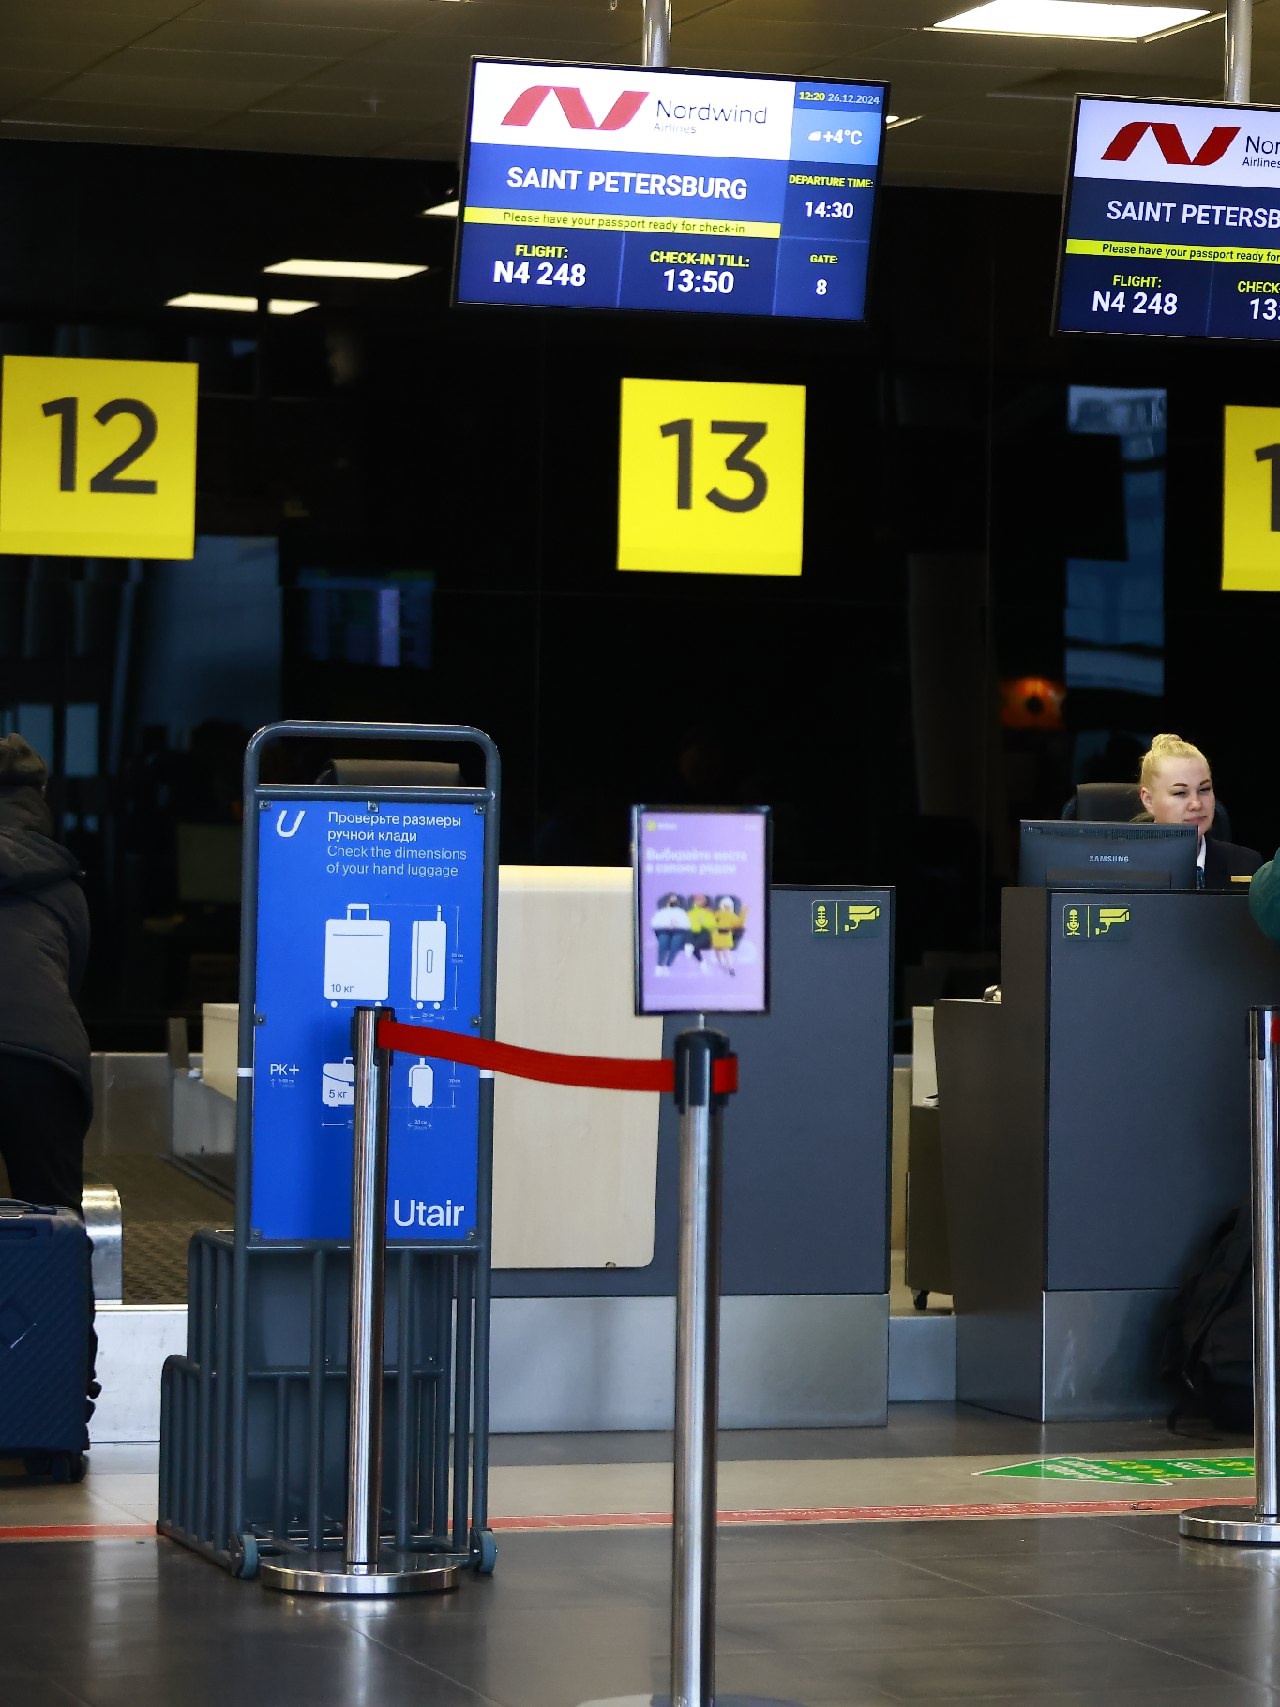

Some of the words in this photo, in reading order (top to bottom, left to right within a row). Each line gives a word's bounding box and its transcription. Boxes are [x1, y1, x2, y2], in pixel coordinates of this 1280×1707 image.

[799, 91, 825, 101] 12:20
[827, 93, 880, 105] 26.12.2024
[656, 99, 767, 126] Nordwind
[507, 166, 582, 190] SAINT
[588, 172, 747, 200] PETERSBURG
[789, 174, 844, 187] DEPARTURE
[847, 178, 874, 188] TIME:
[804, 201, 853, 219] 14:30
[1106, 200, 1176, 223] SAINT
[503, 213, 540, 224] Please
[543, 214, 567, 225] have
[570, 216, 595, 228] your
[598, 218, 646, 230] passport
[648, 220, 679, 233] ready
[681, 221, 697, 232] for
[699, 223, 745, 234] check-in
[515, 245, 568, 259] FLIGHT:
[650, 251, 715, 265] CHECK-IN
[718, 255, 749, 267] TILL:
[810, 255, 838, 265] GATE:
[1102, 243, 1137, 255] Please
[1139, 245, 1162, 256] have
[1165, 248, 1187, 259] your
[1189, 248, 1234, 262] passport
[1236, 251, 1263, 263] ready
[1266, 253, 1280, 262] for
[493, 261, 530, 284] N4
[536, 262, 586, 287] 248
[663, 270, 735, 294] 13:50
[1113, 275, 1162, 289] FLIGHT:
[816, 280, 827, 295] 8
[1092, 290, 1125, 313] N4
[1133, 292, 1178, 316] 248
[41, 396, 159, 495] 12
[659, 417, 768, 512] 13
[328, 811, 399, 825] Проверьте
[403, 815, 461, 828] размеры
[327, 830, 374, 843] ручной
[378, 831, 417, 843] клади
[327, 846, 368, 858] Check
[371, 847, 391, 858] the
[395, 847, 466, 860] dimensions
[327, 864, 340, 874] of
[342, 865, 369, 876] your
[373, 864, 404, 875] hand
[408, 864, 459, 878] luggage
[331, 984, 341, 992] 10
[343, 985, 354, 993] кг
[329, 1090, 335, 1098] 5
[336, 1091, 347, 1099] кг
[394, 1200, 464, 1227] Utair
